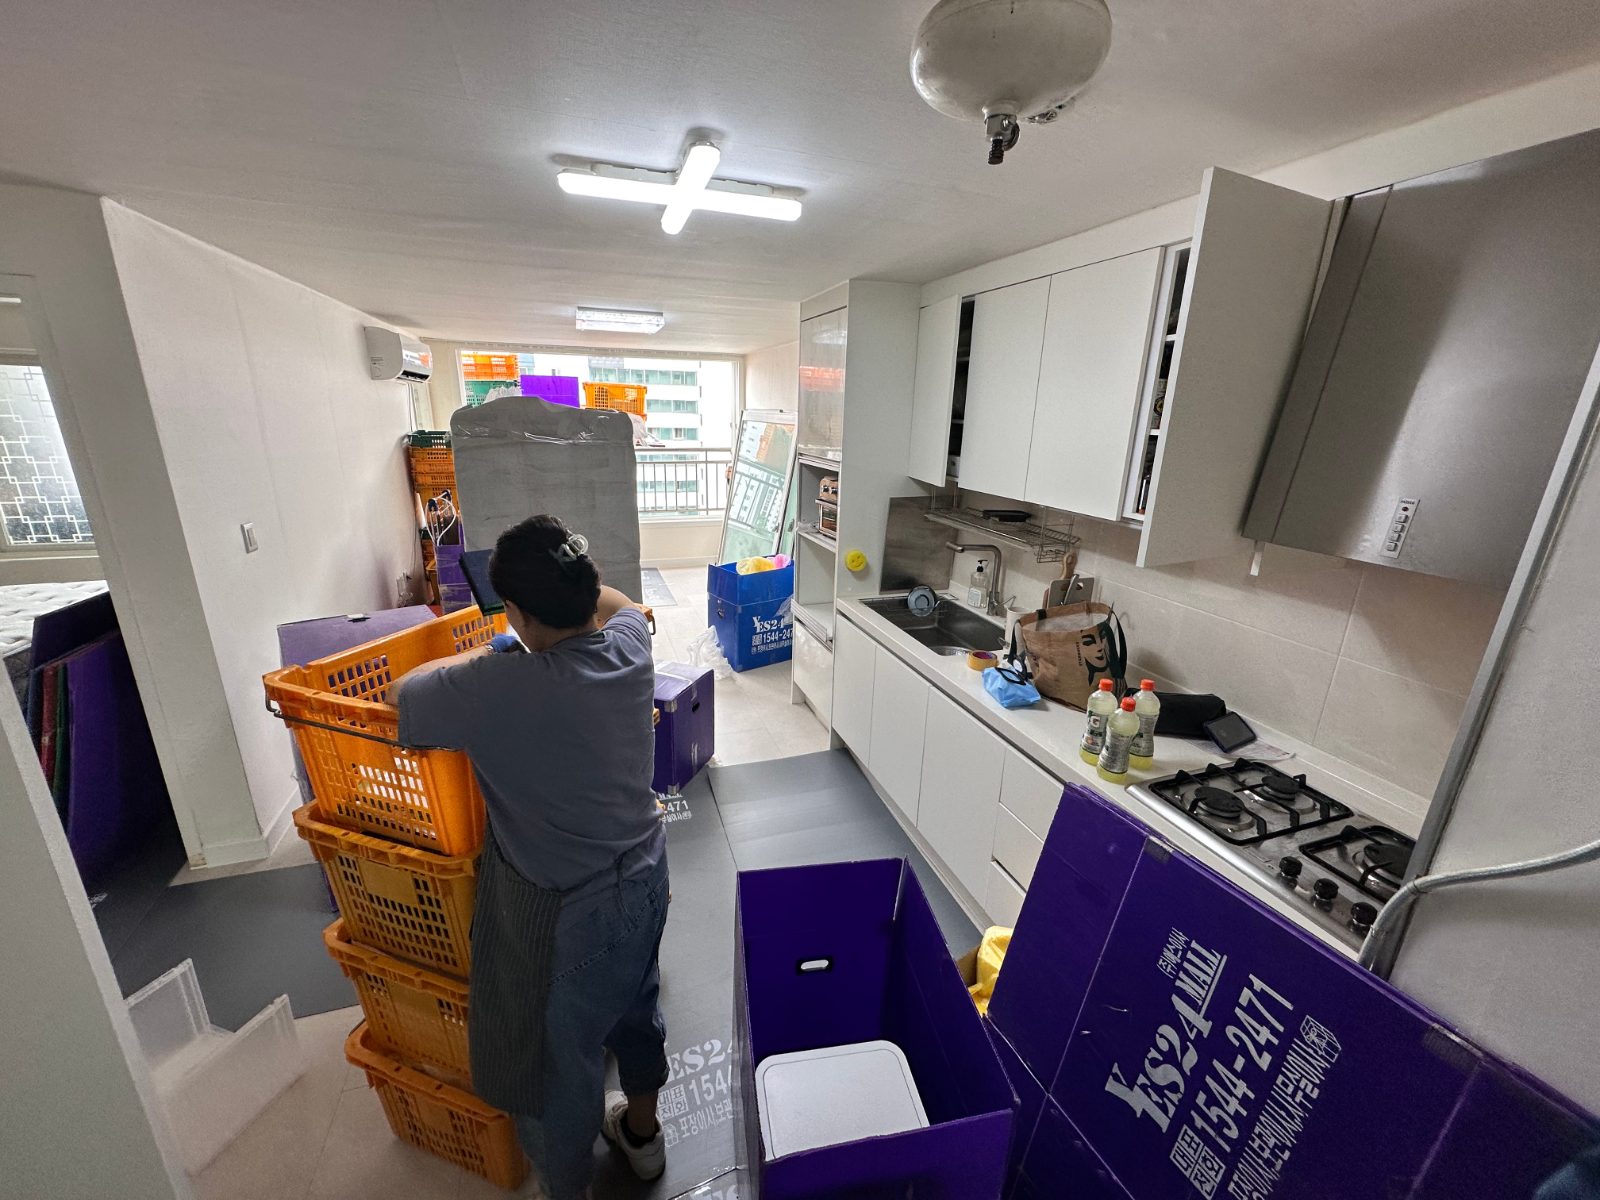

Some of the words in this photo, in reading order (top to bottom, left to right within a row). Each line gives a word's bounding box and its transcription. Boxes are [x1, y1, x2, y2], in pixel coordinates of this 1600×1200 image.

[752, 616, 784, 633] YES24
[664, 800, 689, 813] 471
[1104, 993, 1213, 1134] YES24
[1174, 939, 1222, 1006] MALL
[665, 1039, 732, 1082] ES2
[1190, 973, 1294, 1153] 1544-2471
[689, 1065, 732, 1105] 154
